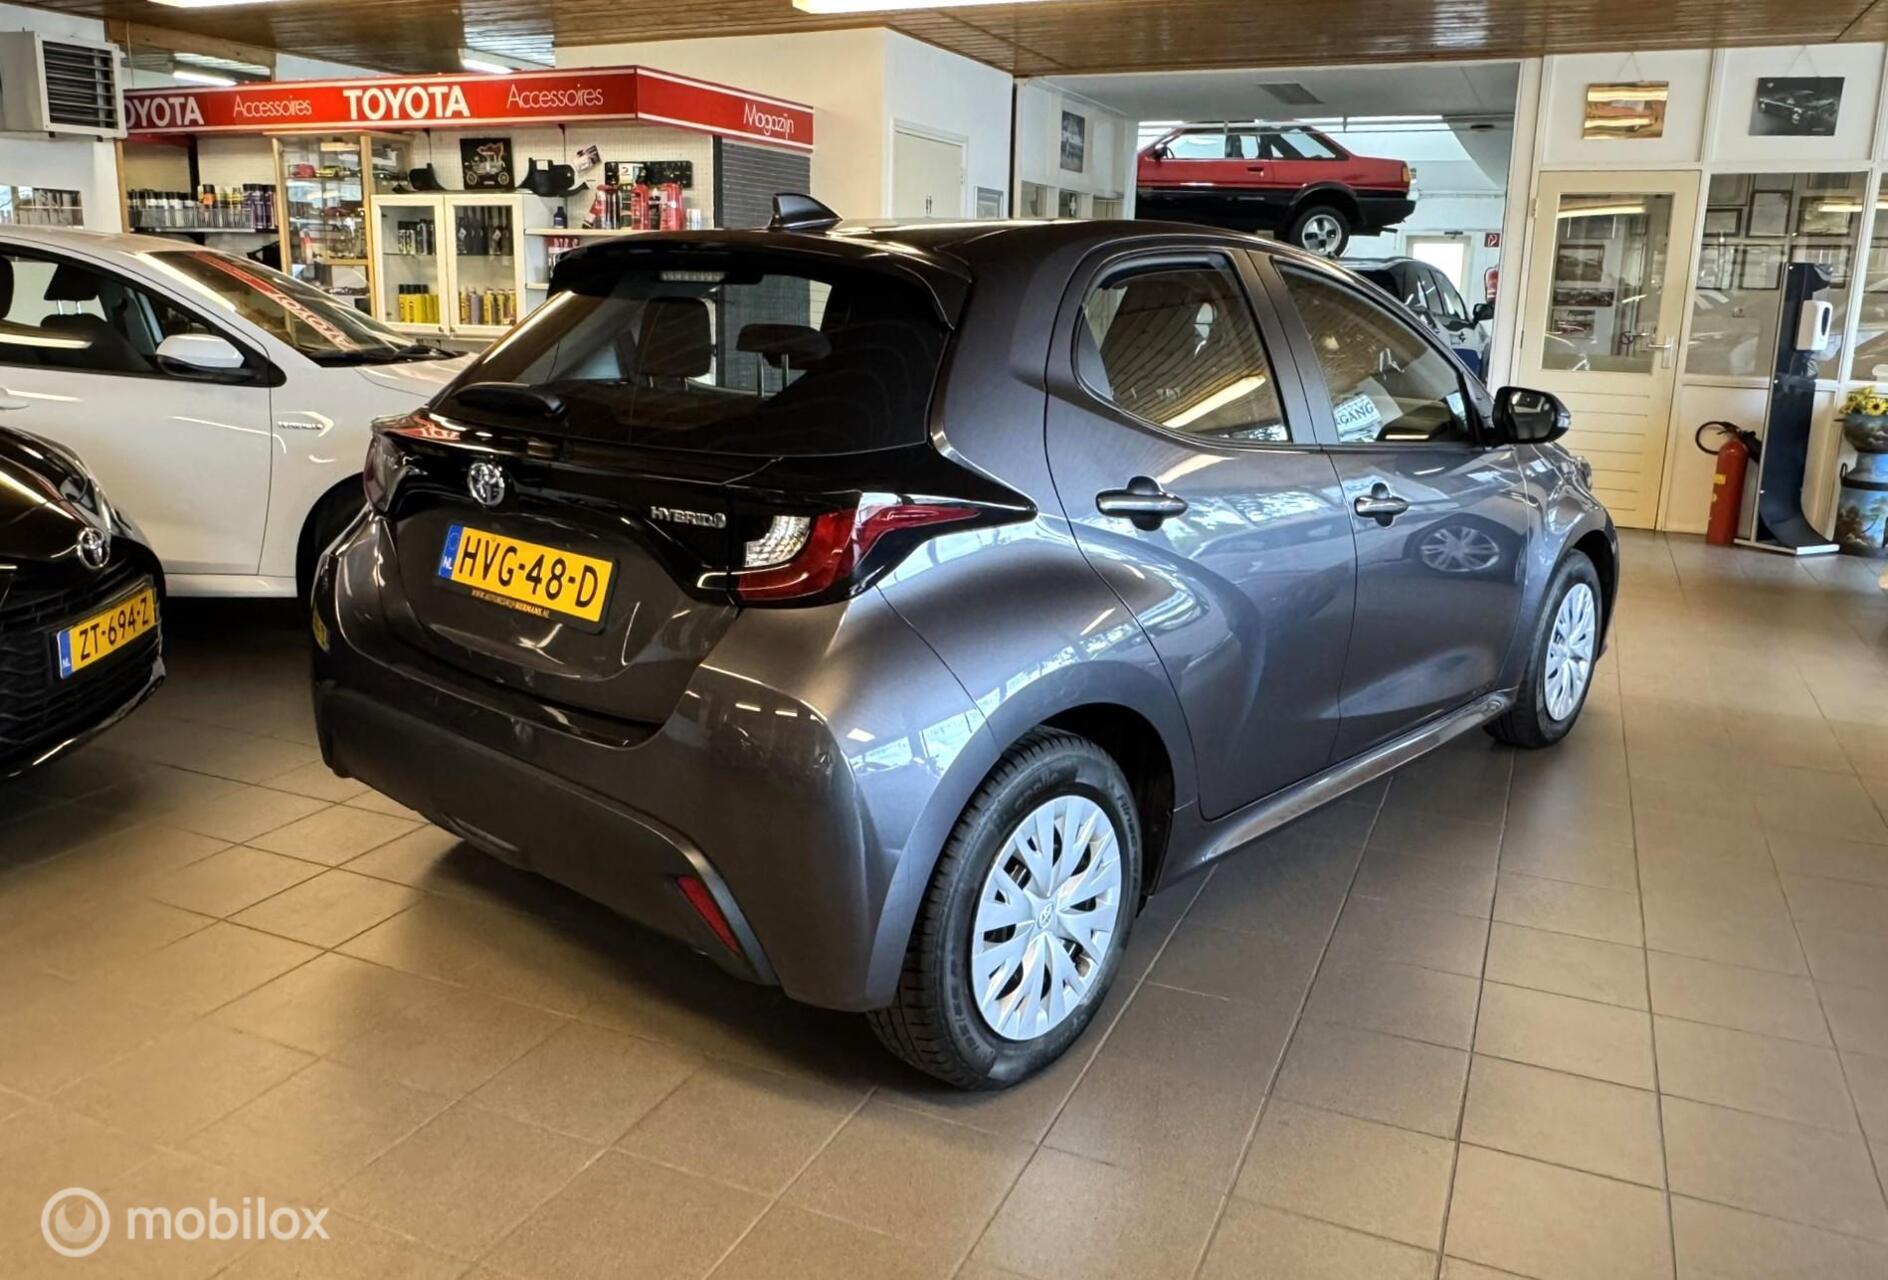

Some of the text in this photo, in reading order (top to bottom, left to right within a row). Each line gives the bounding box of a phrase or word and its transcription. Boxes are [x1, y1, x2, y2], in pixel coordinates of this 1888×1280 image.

[124, 83, 604, 128] OYOTA Accessoires TOYOTA Accessoires
[743, 102, 794, 140] Magazijn
[1336, 401, 1374, 426] GANG
[650, 505, 713, 527] HYBRID
[458, 535, 599, 608] HVG-48-D
[79, 597, 149, 661] ZT-694-Z
